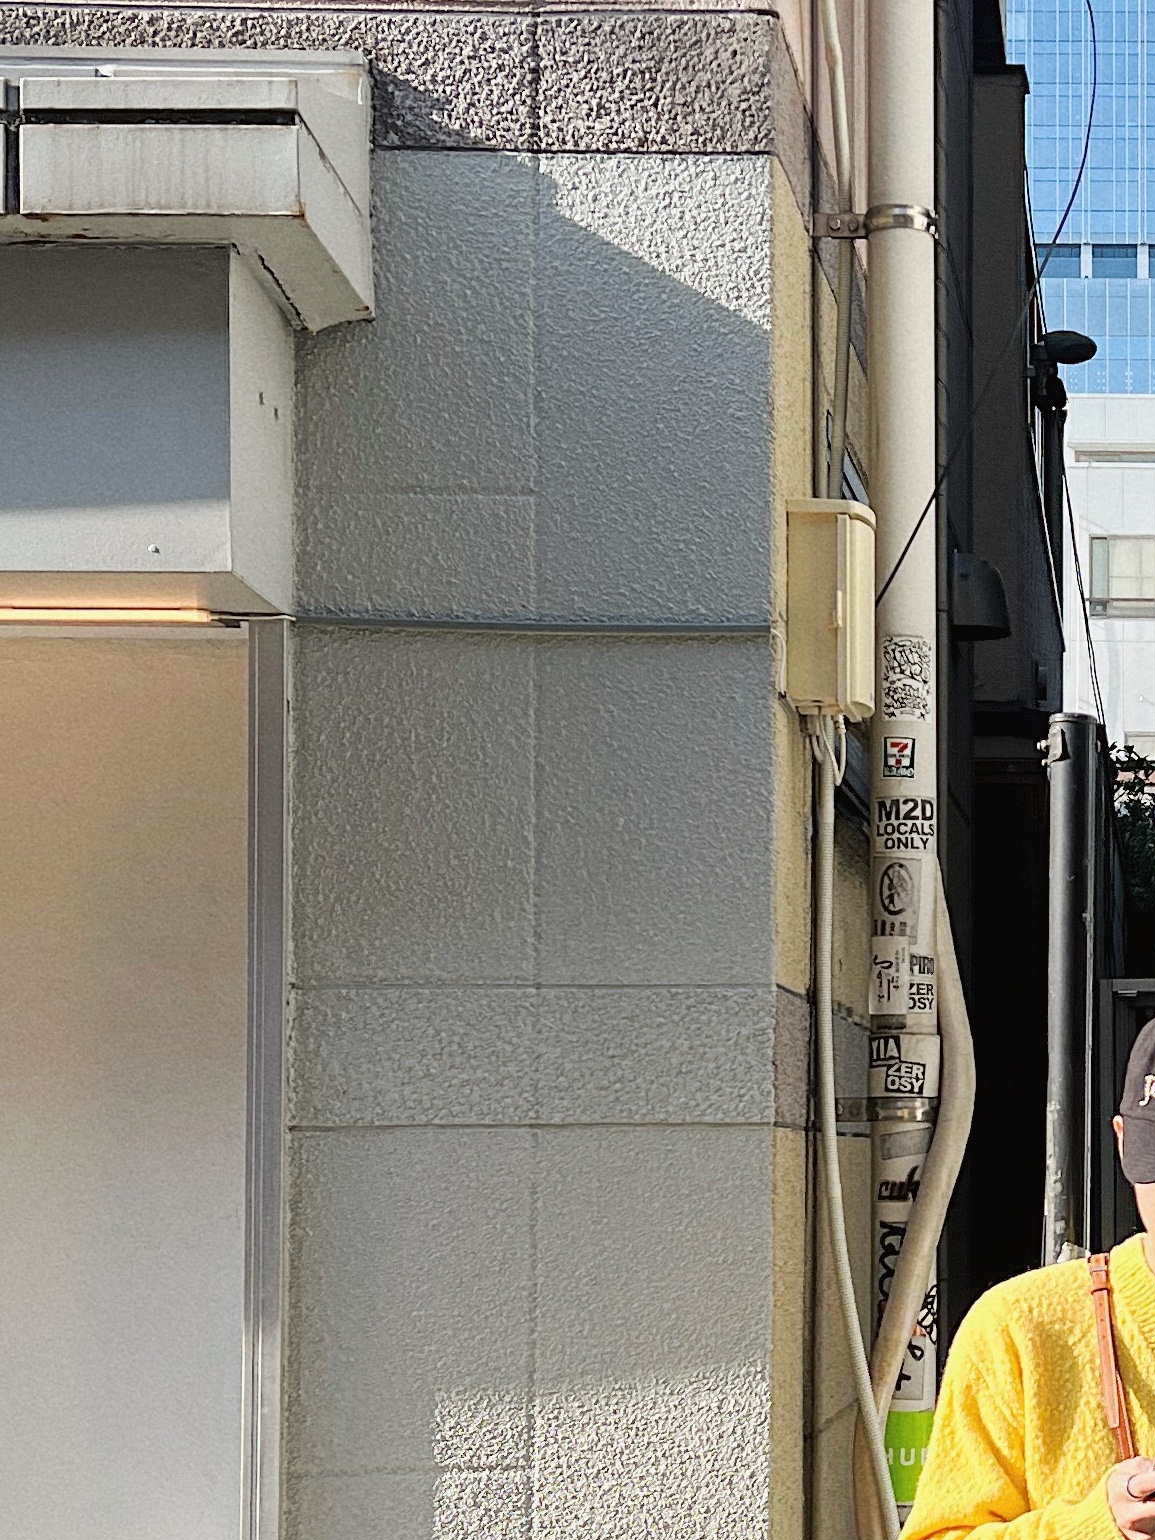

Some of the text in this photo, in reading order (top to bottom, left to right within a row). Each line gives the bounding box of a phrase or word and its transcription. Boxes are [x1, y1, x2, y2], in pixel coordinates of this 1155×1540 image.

[877, 798, 934, 822] M2D
[876, 822, 935, 837] LOCALS
[884, 836, 930, 850] ONLY
[887, 1060, 924, 1080] ZER
[886, 1075, 925, 1093] OSY
